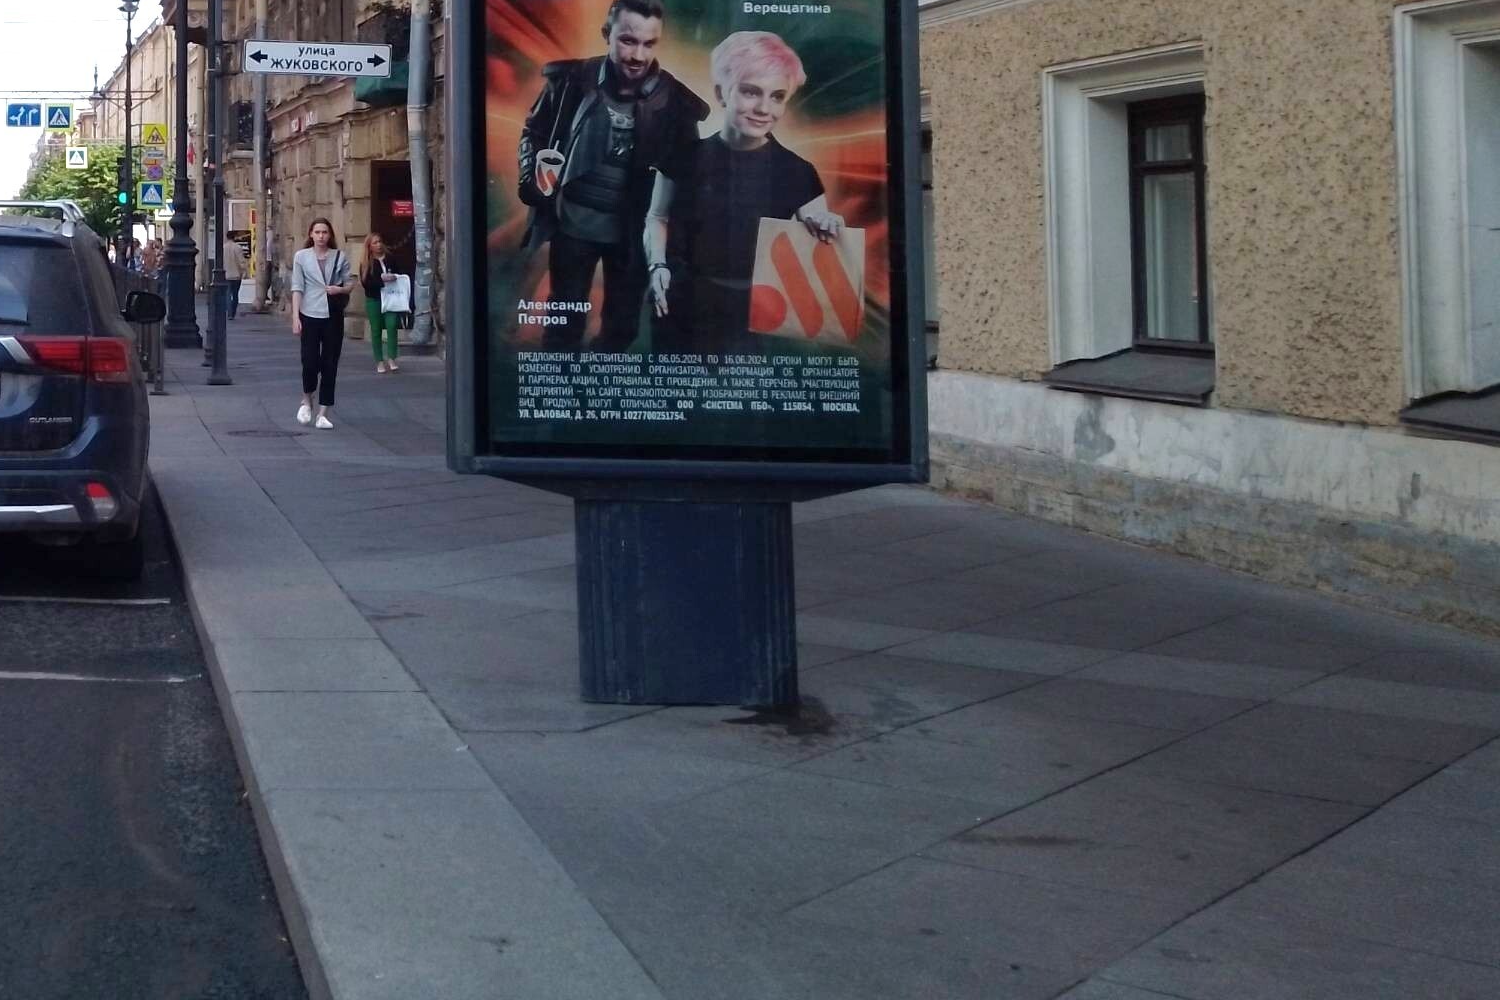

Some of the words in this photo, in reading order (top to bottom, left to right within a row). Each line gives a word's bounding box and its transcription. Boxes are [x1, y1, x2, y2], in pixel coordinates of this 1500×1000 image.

[743, 2, 831, 15] Верещагина
[299, 46, 335, 57] улица
[270, 57, 363, 72] ЖУКОВСКОГО
[517, 299, 592, 313] Александр
[518, 313, 568, 327] Петров
[518, 352, 575, 362] ПРЕДЛОЖЕНИЕ
[580, 352, 643, 363] ДЕЙСТВИТЕЛЬНО
[658, 354, 702, 364] 06.05.2024
[708, 355, 719, 364] ПО
[772, 355, 802, 366] (СРОКИ
[808, 356, 832, 366] МОГУТ
[839, 357, 859, 366] БЫТЬ
[518, 364, 562, 373] ИЗМЕНЕНЫ
[570, 364, 581, 373] ПО
[589, 365, 641, 374] УСМОТРЕНИЮ
[719, 367, 774, 377] ИНФОРМАЦИЯ
[783, 367, 794, 377] ОБ
[803, 367, 859, 377] ОРГАНИЗАТОРЕ
[518, 375, 524, 384] И
[528, 375, 568, 384] ПАРТНЕРАХ
[613, 377, 651, 385] ПРАВИЛАХ
[731, 378, 755, 387] ТАКЖЕ
[760, 378, 798, 388] ПЕРЕЧЕНЬ
[802, 379, 860, 389] УЧАСТВУЮЩИХ
[518, 386, 573, 396] ПРЕДПРИЯТИЙ
[586, 387, 596, 396] НА
[599, 387, 622, 396] САЙТЕ
[703, 389, 760, 399] ИЗОБРАЖЕНИЕ
[771, 390, 807, 399] РЕКЛАМЕ
[820, 390, 860, 400] ВНЕШНИЙ
[519, 398, 536, 408] ВИД
[543, 399, 580, 408] ПРОДУКТА
[588, 399, 612, 408] МОГУТ
[600, 410, 621, 420] ОГРН
